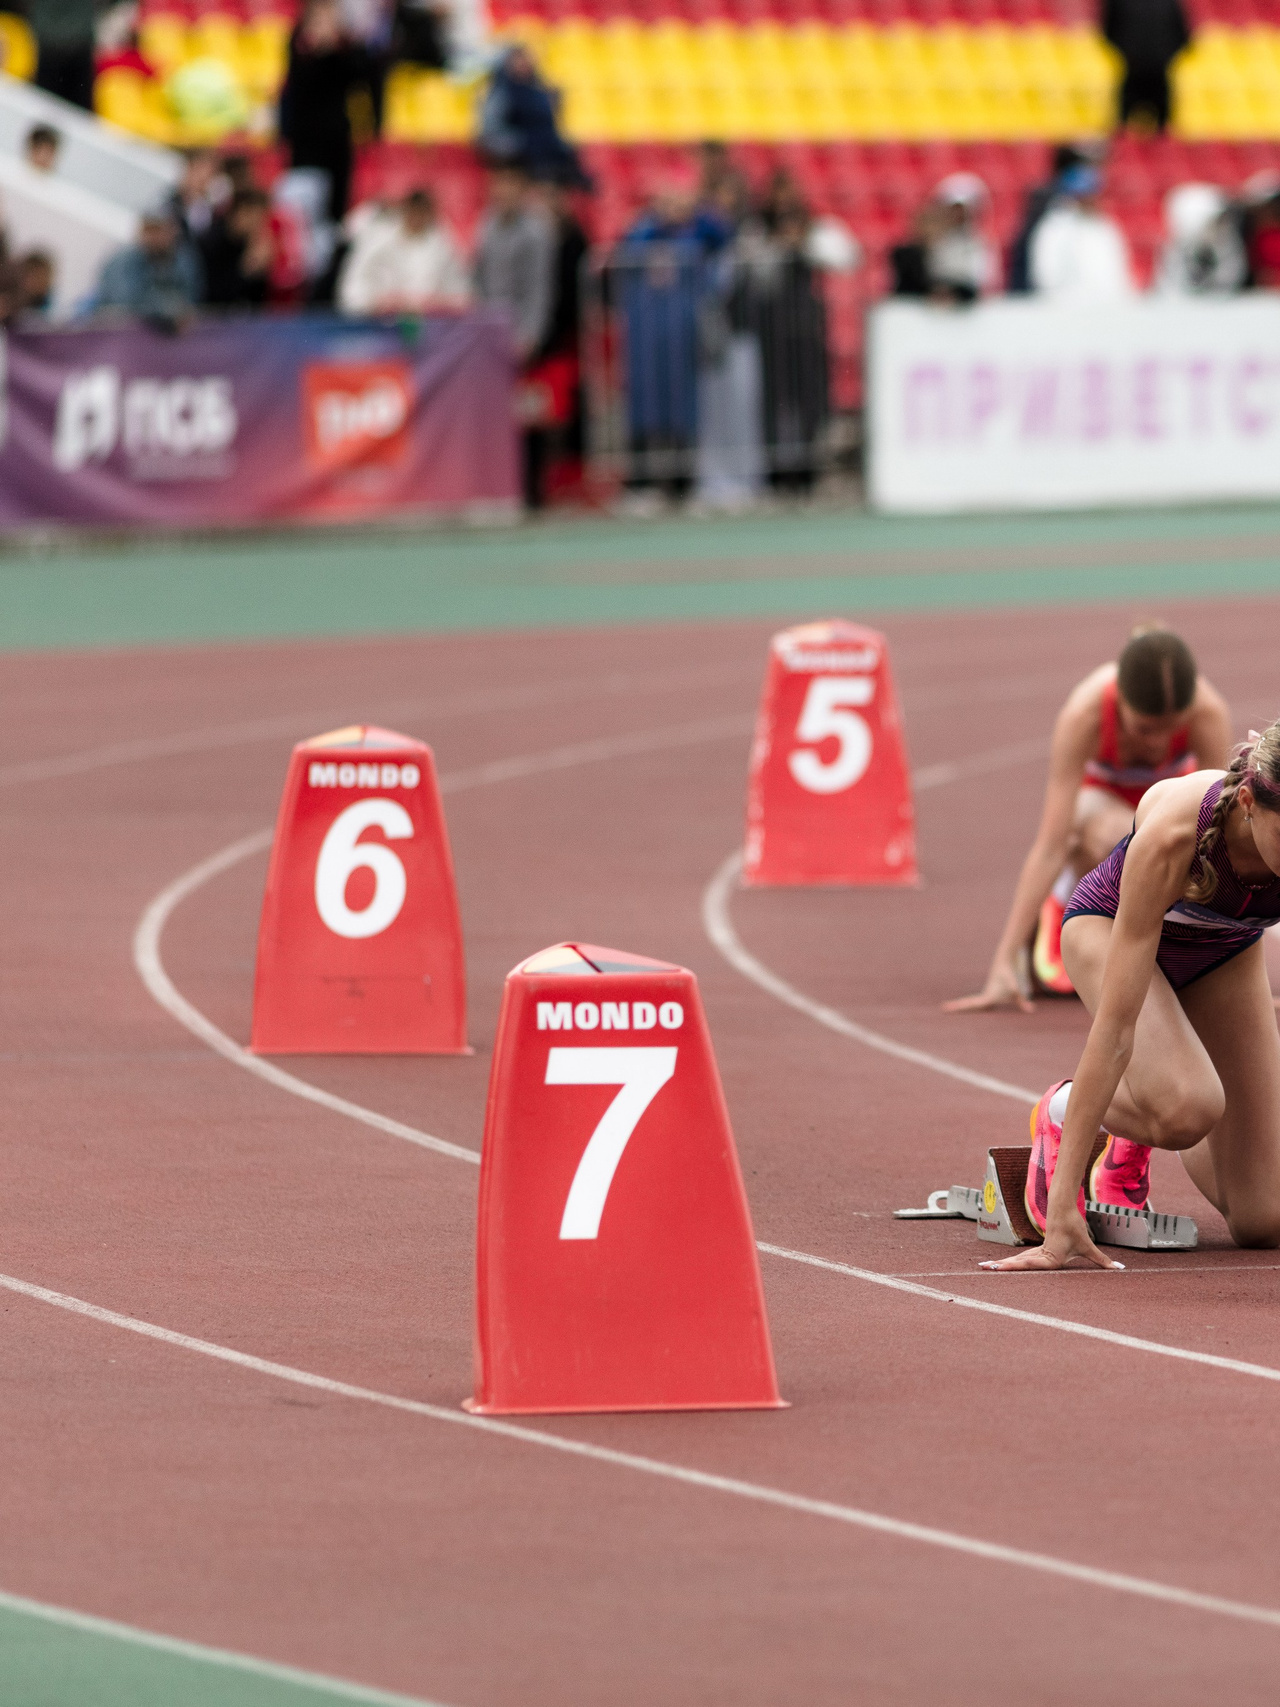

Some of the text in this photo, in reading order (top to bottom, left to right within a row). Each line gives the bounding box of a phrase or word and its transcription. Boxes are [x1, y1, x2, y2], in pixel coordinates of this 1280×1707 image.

[308, 763, 420, 788] MONDO
[787, 675, 876, 795] 5
[315, 797, 414, 938] 6
[536, 1001, 684, 1030] MONDO
[544, 1046, 678, 1240] 7
